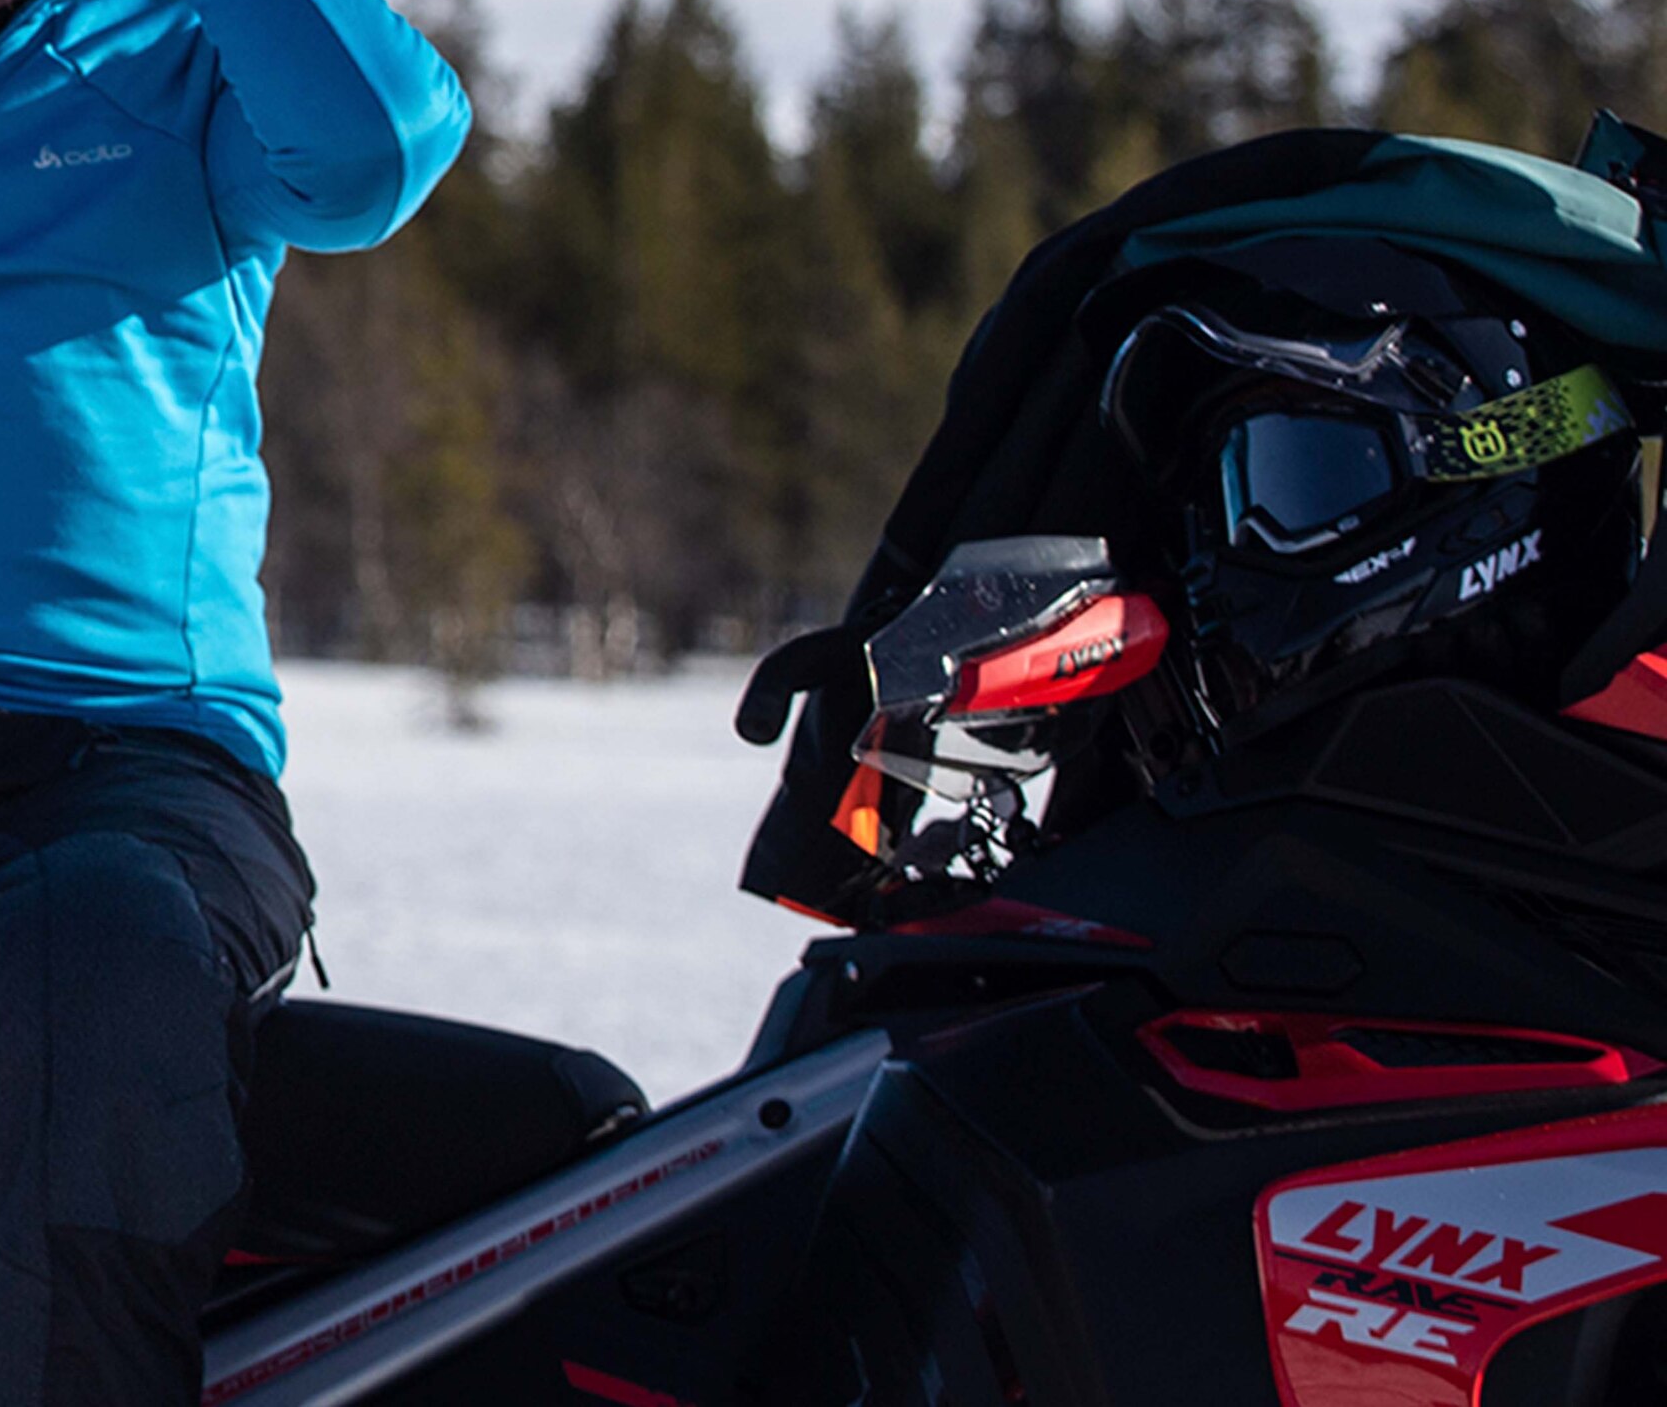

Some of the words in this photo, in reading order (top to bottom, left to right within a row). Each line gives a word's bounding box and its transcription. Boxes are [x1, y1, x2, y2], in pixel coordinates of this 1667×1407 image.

[1459, 529, 1542, 601] LYNX
[1301, 1199, 1562, 1293] LYNX
[1283, 1288, 1476, 1366] RE
[1295, 1257, 1505, 1323] RAVE
